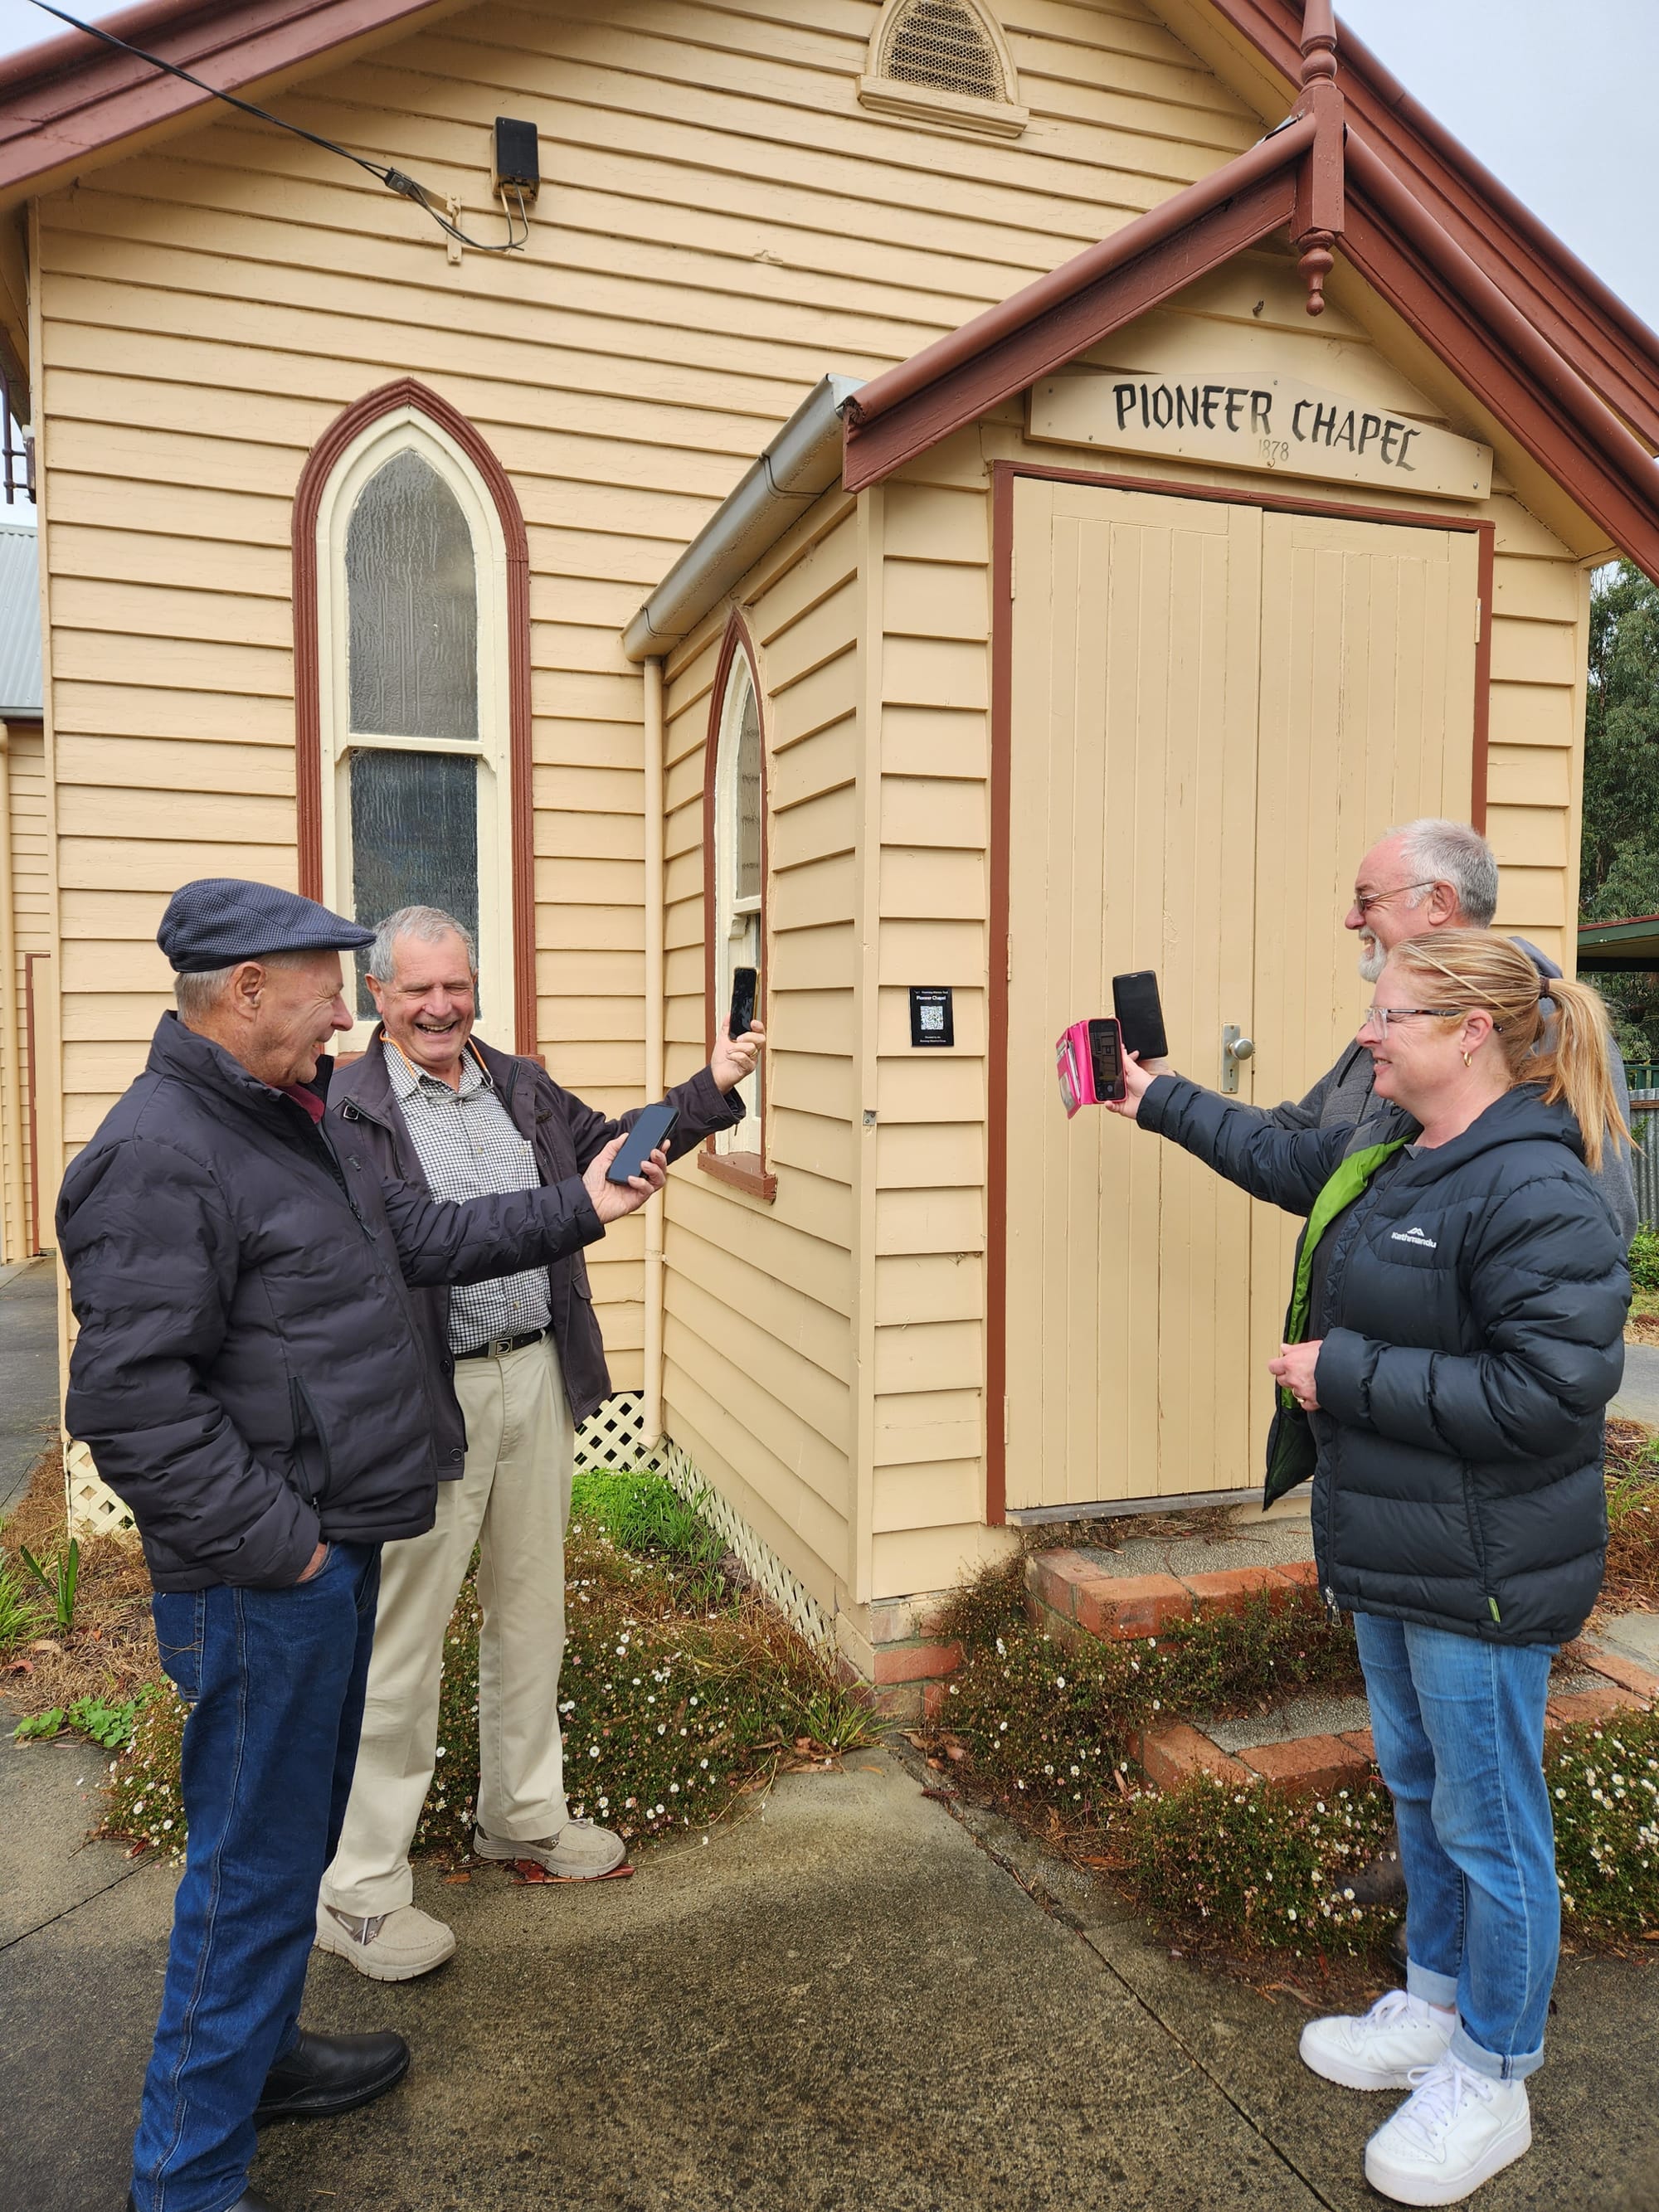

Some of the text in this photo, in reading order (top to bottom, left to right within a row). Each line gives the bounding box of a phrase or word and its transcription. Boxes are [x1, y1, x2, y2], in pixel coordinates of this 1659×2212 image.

[1112, 383, 1421, 471] PIONEER CHAPEL
[1257, 439, 1289, 462] 1878
